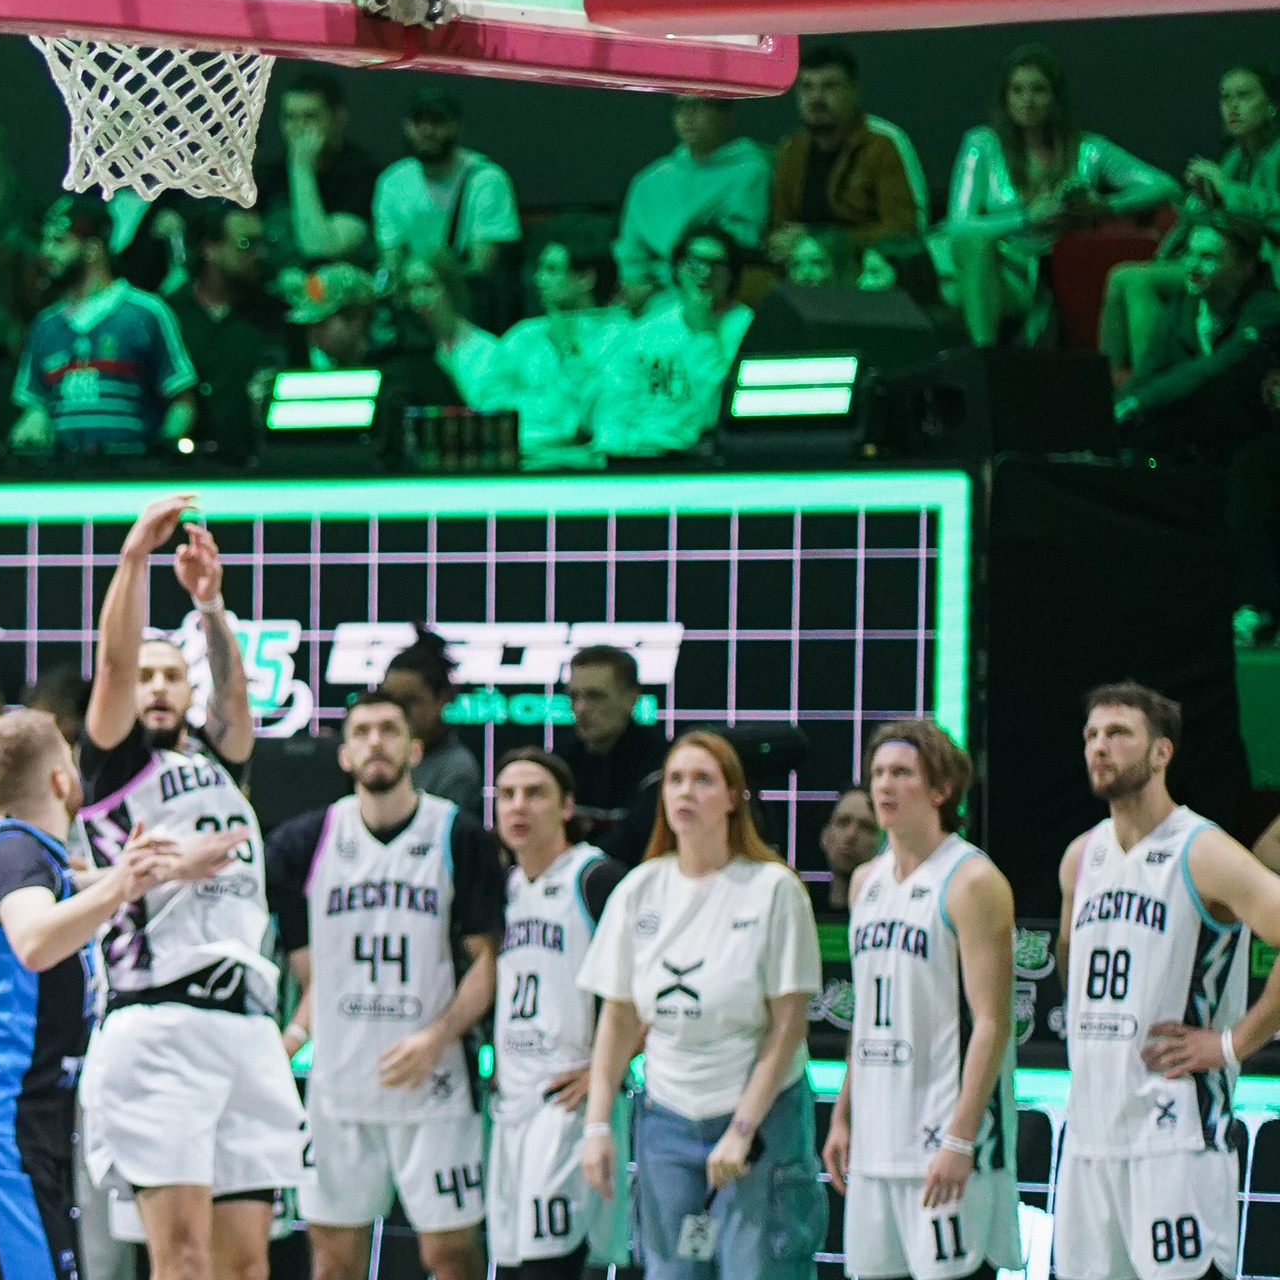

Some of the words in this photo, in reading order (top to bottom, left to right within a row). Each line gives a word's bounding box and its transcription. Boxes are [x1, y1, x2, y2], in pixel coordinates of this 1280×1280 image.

[353, 933, 409, 984] 44
[1087, 949, 1131, 1000] 88
[874, 977, 892, 1027] 11
[436, 1162, 483, 1209] 44
[534, 1195, 571, 1239] 10
[931, 1214, 967, 1261] 11
[1151, 1216, 1201, 1264] 88
